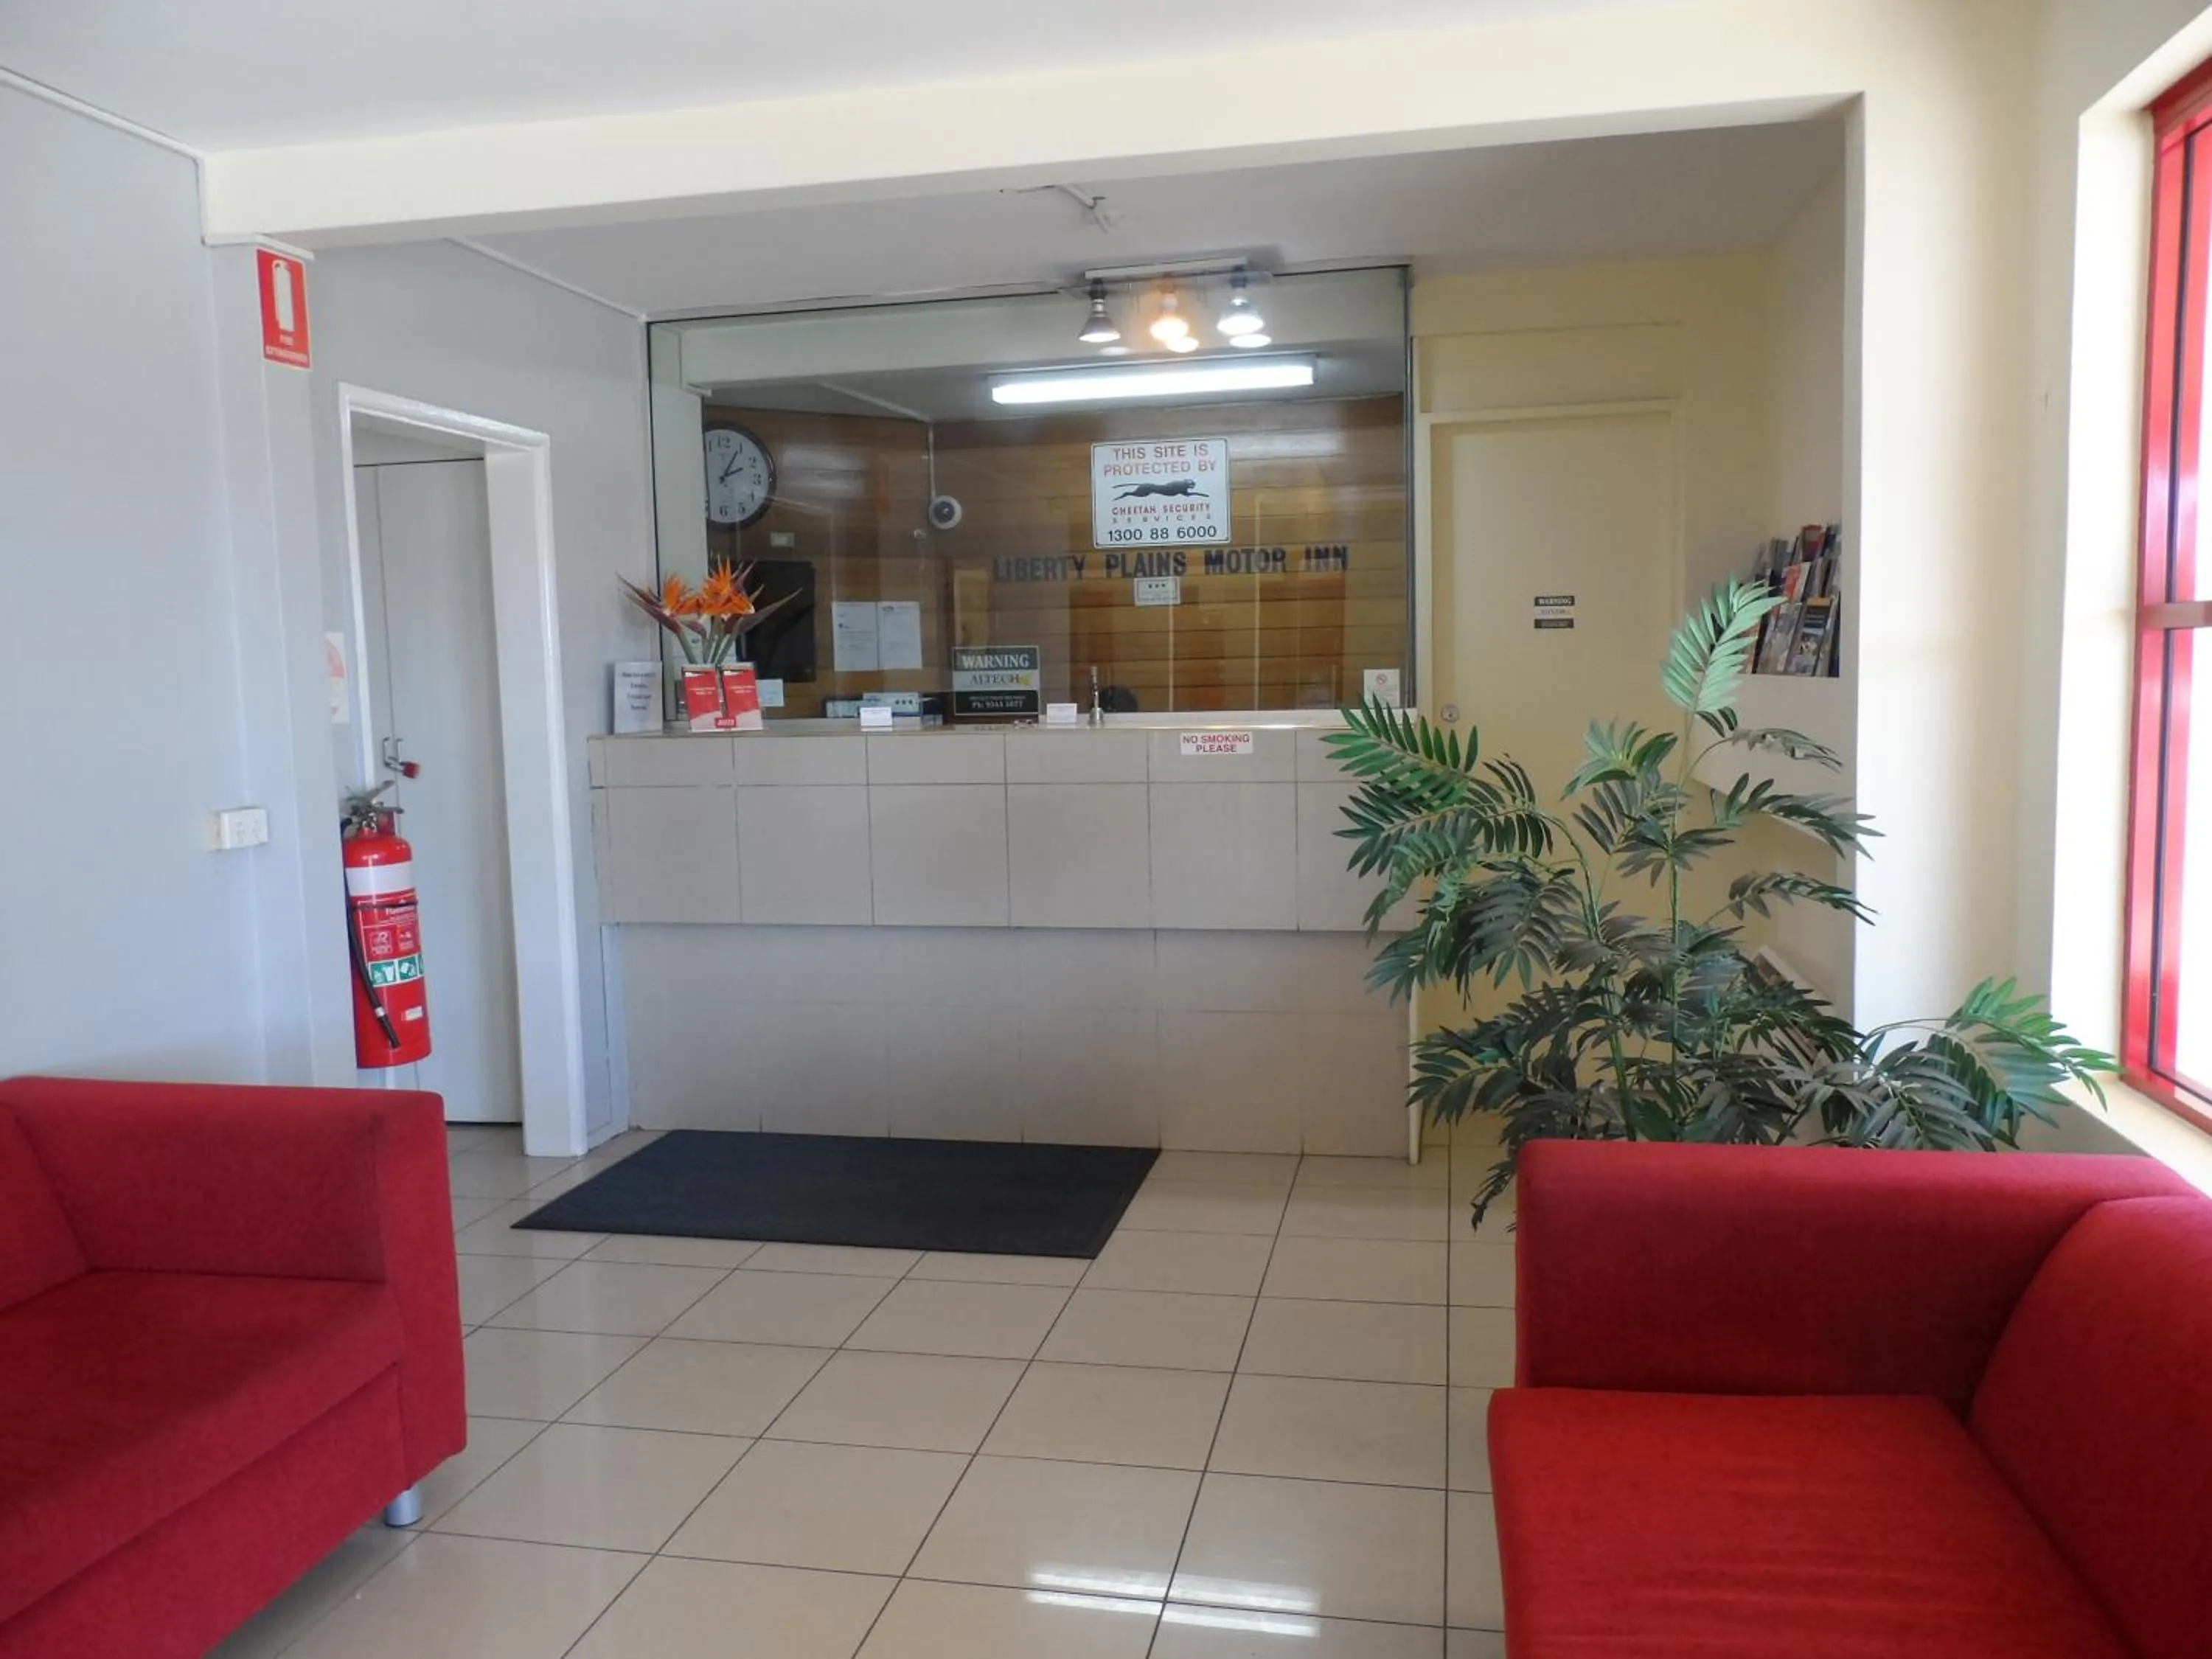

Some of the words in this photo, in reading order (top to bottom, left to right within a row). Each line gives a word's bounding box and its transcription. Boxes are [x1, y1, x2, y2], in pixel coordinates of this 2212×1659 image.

[1113, 447, 1146, 460] THIS
[1153, 445, 1186, 458] SITE
[1194, 443, 1209, 456] IS
[1104, 461, 1192, 476] PROTECTED
[1198, 459, 1217, 472] BY
[1111, 504, 1157, 515] CHEETAH
[1163, 502, 1211, 513] SECURITY
[1108, 528, 1143, 542] 1300
[1150, 527, 1169, 540] 88
[1177, 525, 1217, 539] 6000
[992, 554, 1086, 583] LIBERTY
[1105, 551, 1187, 580] PLAINS
[1203, 547, 1287, 576] MOTOR
[1304, 544, 1349, 572] INN
[961, 653, 1030, 669] WARNING
[1182, 734, 1198, 744] NO
[1200, 734, 1250, 744] SMOKING
[1195, 743, 1237, 753] PLEASE
